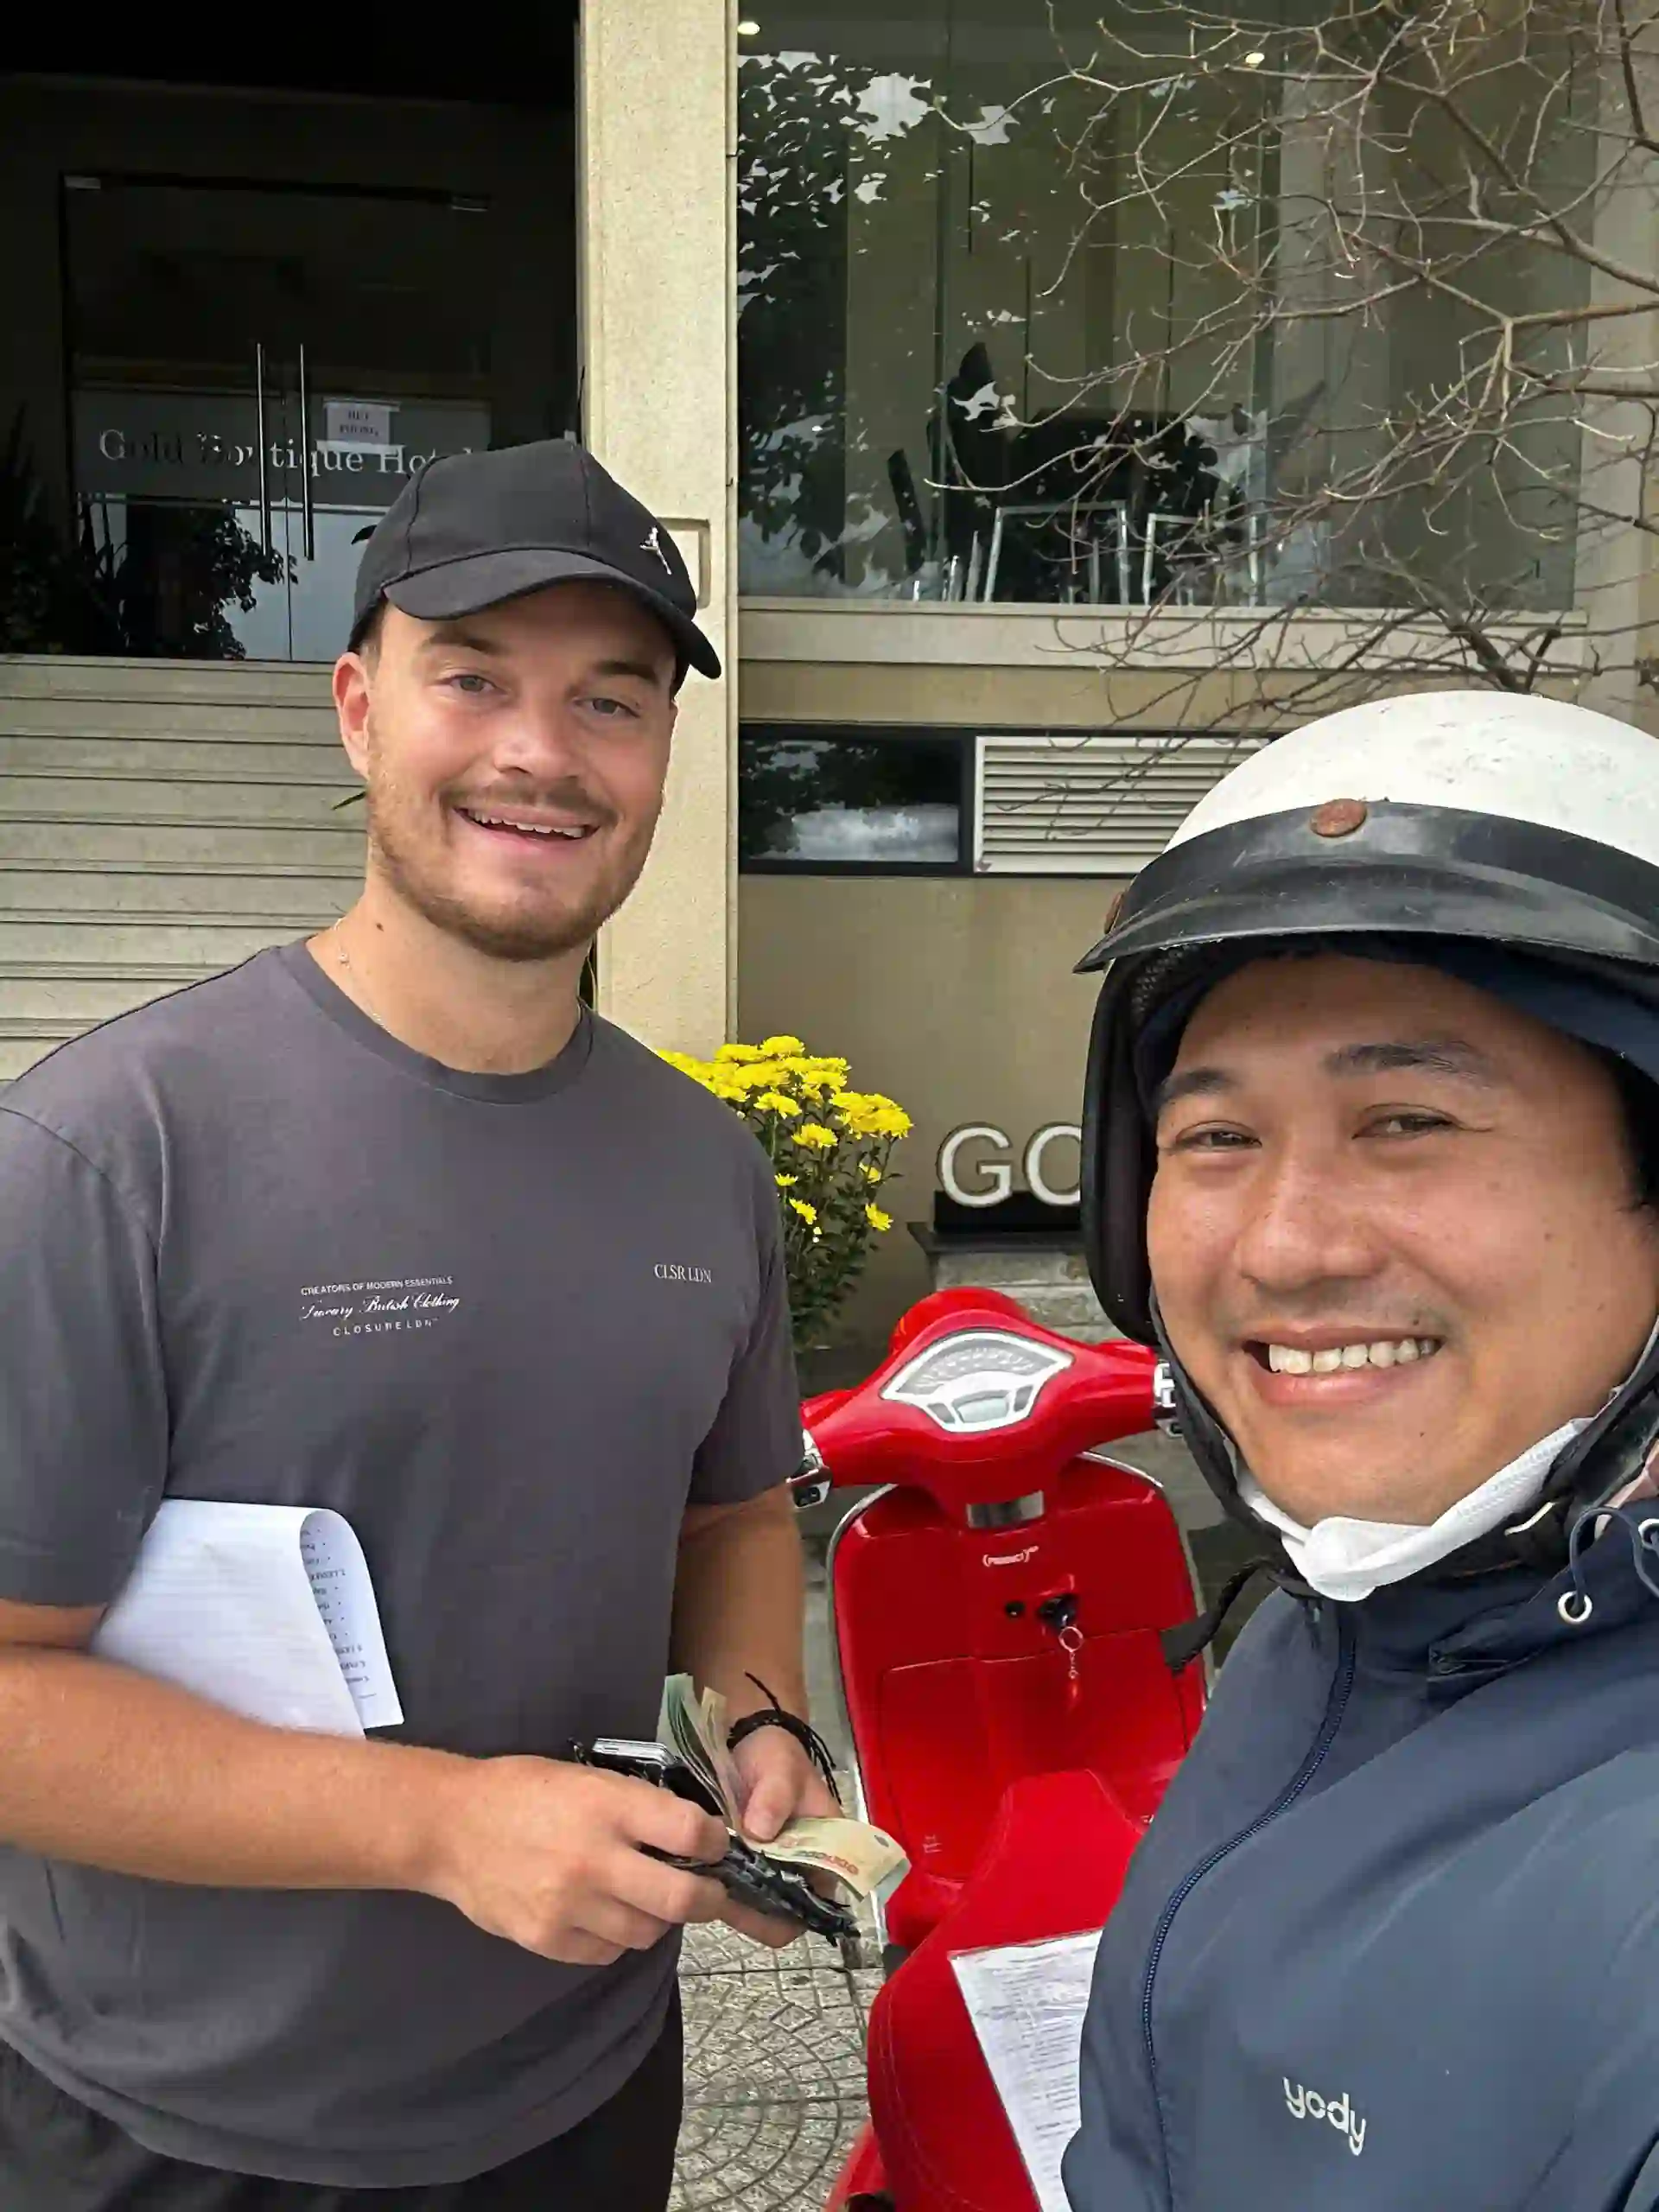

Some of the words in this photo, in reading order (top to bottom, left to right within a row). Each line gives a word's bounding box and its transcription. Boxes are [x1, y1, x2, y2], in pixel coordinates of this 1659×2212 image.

[301, 1283, 352, 1296] CREATORS
[353, 1282, 365, 1291] OF
[366, 1280, 404, 1290] MODERN
[404, 1276, 453, 1287] ESSENTIALS
[1282, 2076, 1366, 2156] yody
